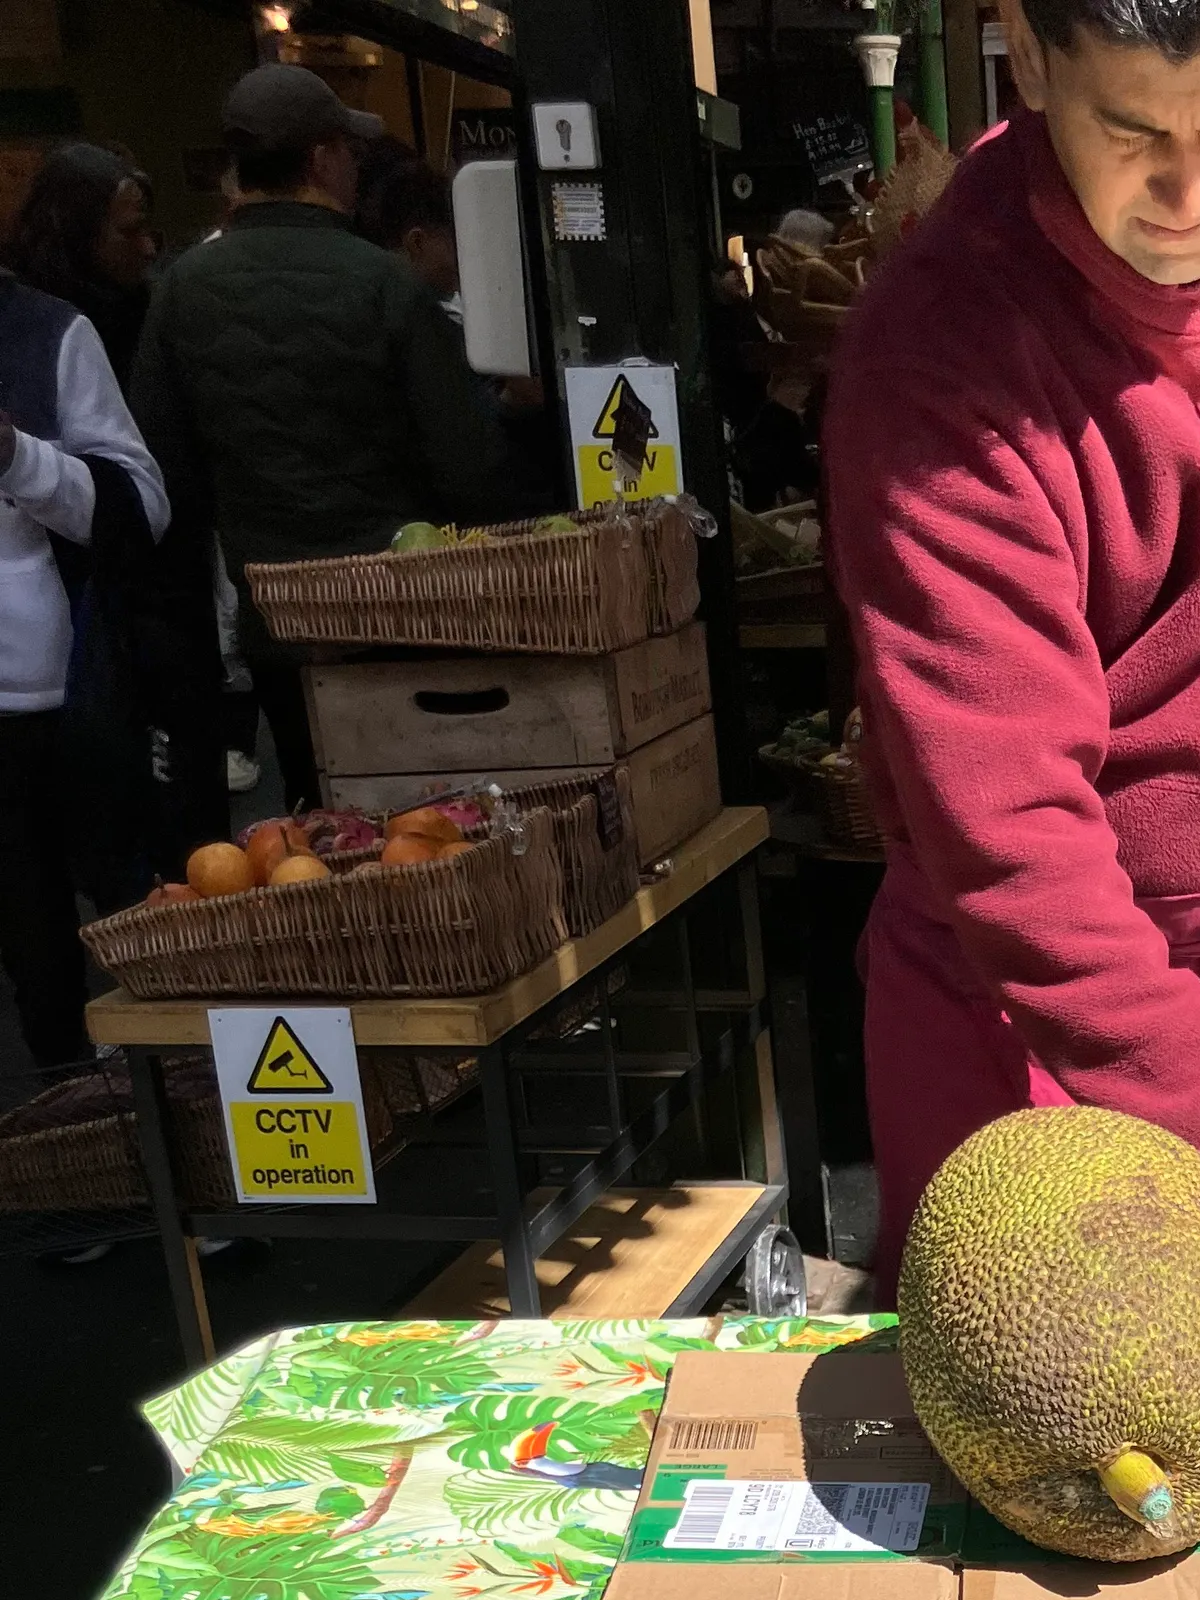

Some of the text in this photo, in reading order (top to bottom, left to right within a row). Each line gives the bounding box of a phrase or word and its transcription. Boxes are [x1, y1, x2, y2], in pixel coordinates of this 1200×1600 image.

[255, 1109, 332, 1134] CCTV
[289, 1139, 309, 1159] in
[252, 1164, 354, 1189] operation
